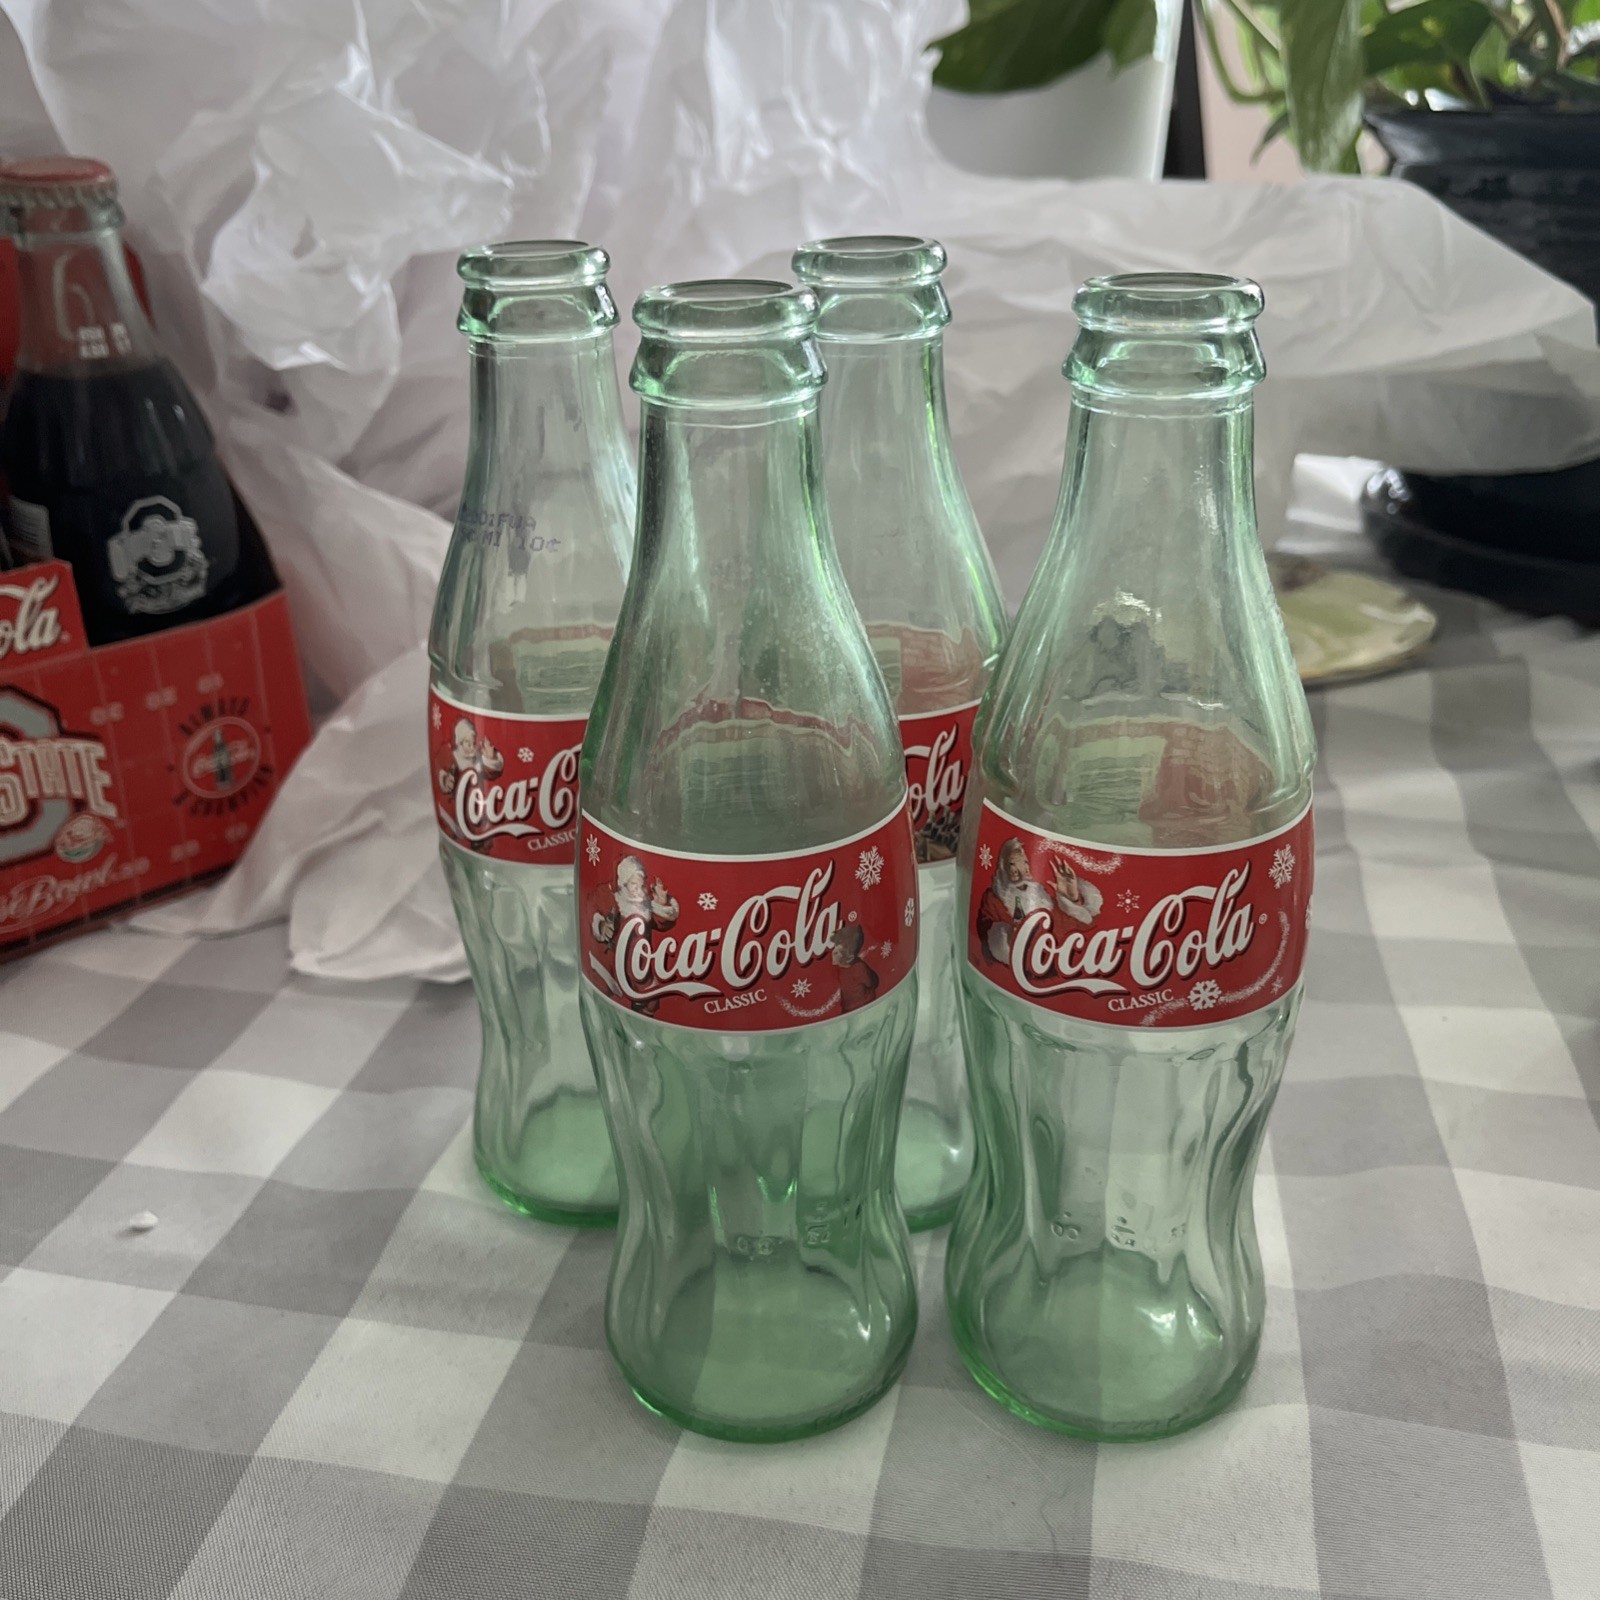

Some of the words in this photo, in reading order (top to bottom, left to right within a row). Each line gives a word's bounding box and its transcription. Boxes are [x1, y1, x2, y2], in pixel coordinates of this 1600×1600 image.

[614, 859, 843, 999] Coca-Cola
[1010, 860, 1255, 995] Coca-Cola
[703, 988, 767, 1015] CLASSIC
[1107, 988, 1174, 1013] CLASSIC
